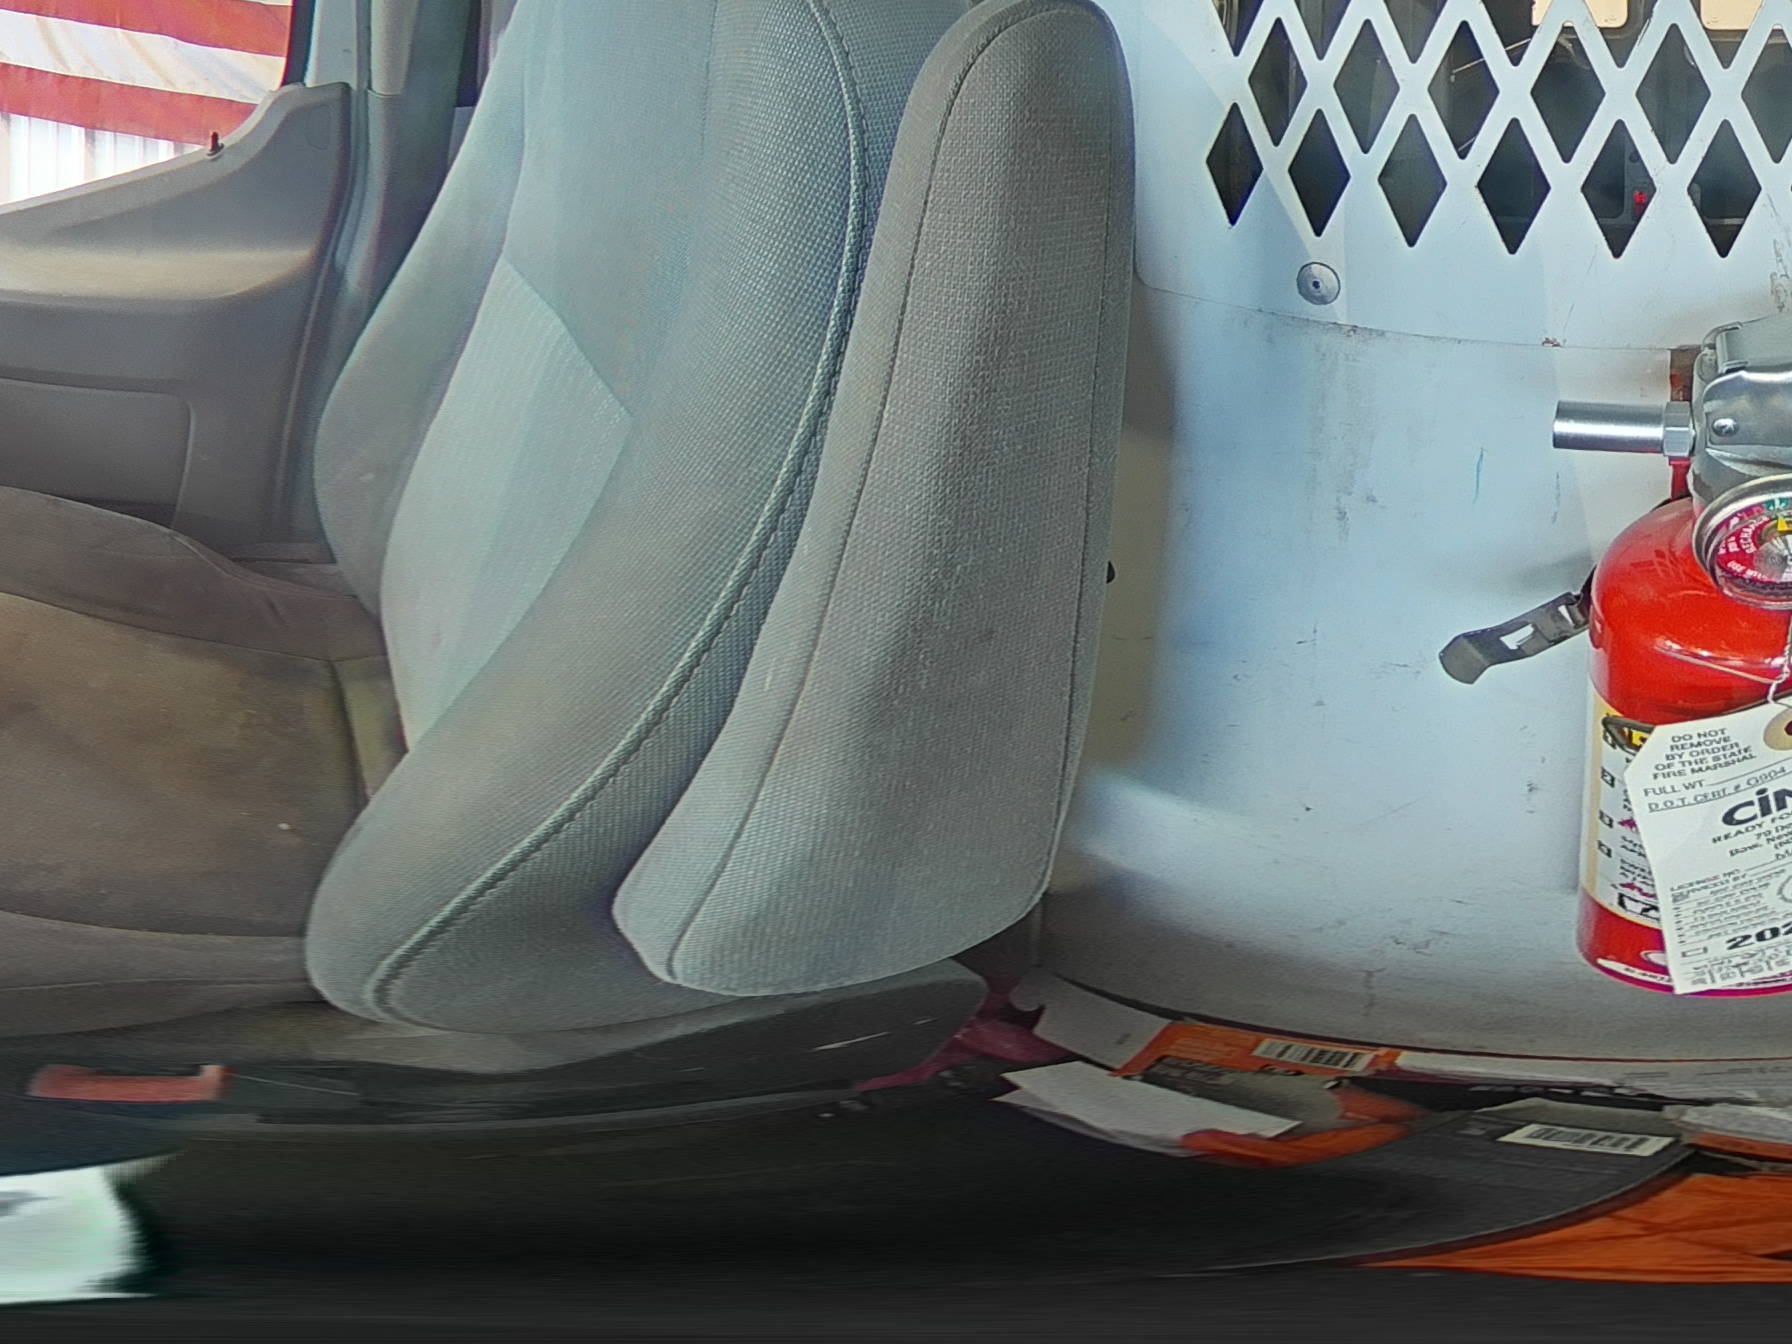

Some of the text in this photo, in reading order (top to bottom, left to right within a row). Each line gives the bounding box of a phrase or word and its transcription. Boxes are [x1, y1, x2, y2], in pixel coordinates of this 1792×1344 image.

[1670, 736, 1731, 752] REMOVE
[1671, 728, 1727, 743] DO NOT
[1654, 745, 1752, 771] OF THE STATE
[1665, 742, 1740, 761] BY ORDER
[1652, 755, 1757, 780] FIRE MARSHAL
[1643, 784, 1680, 798] FULL
[1711, 821, 1765, 844] READY
